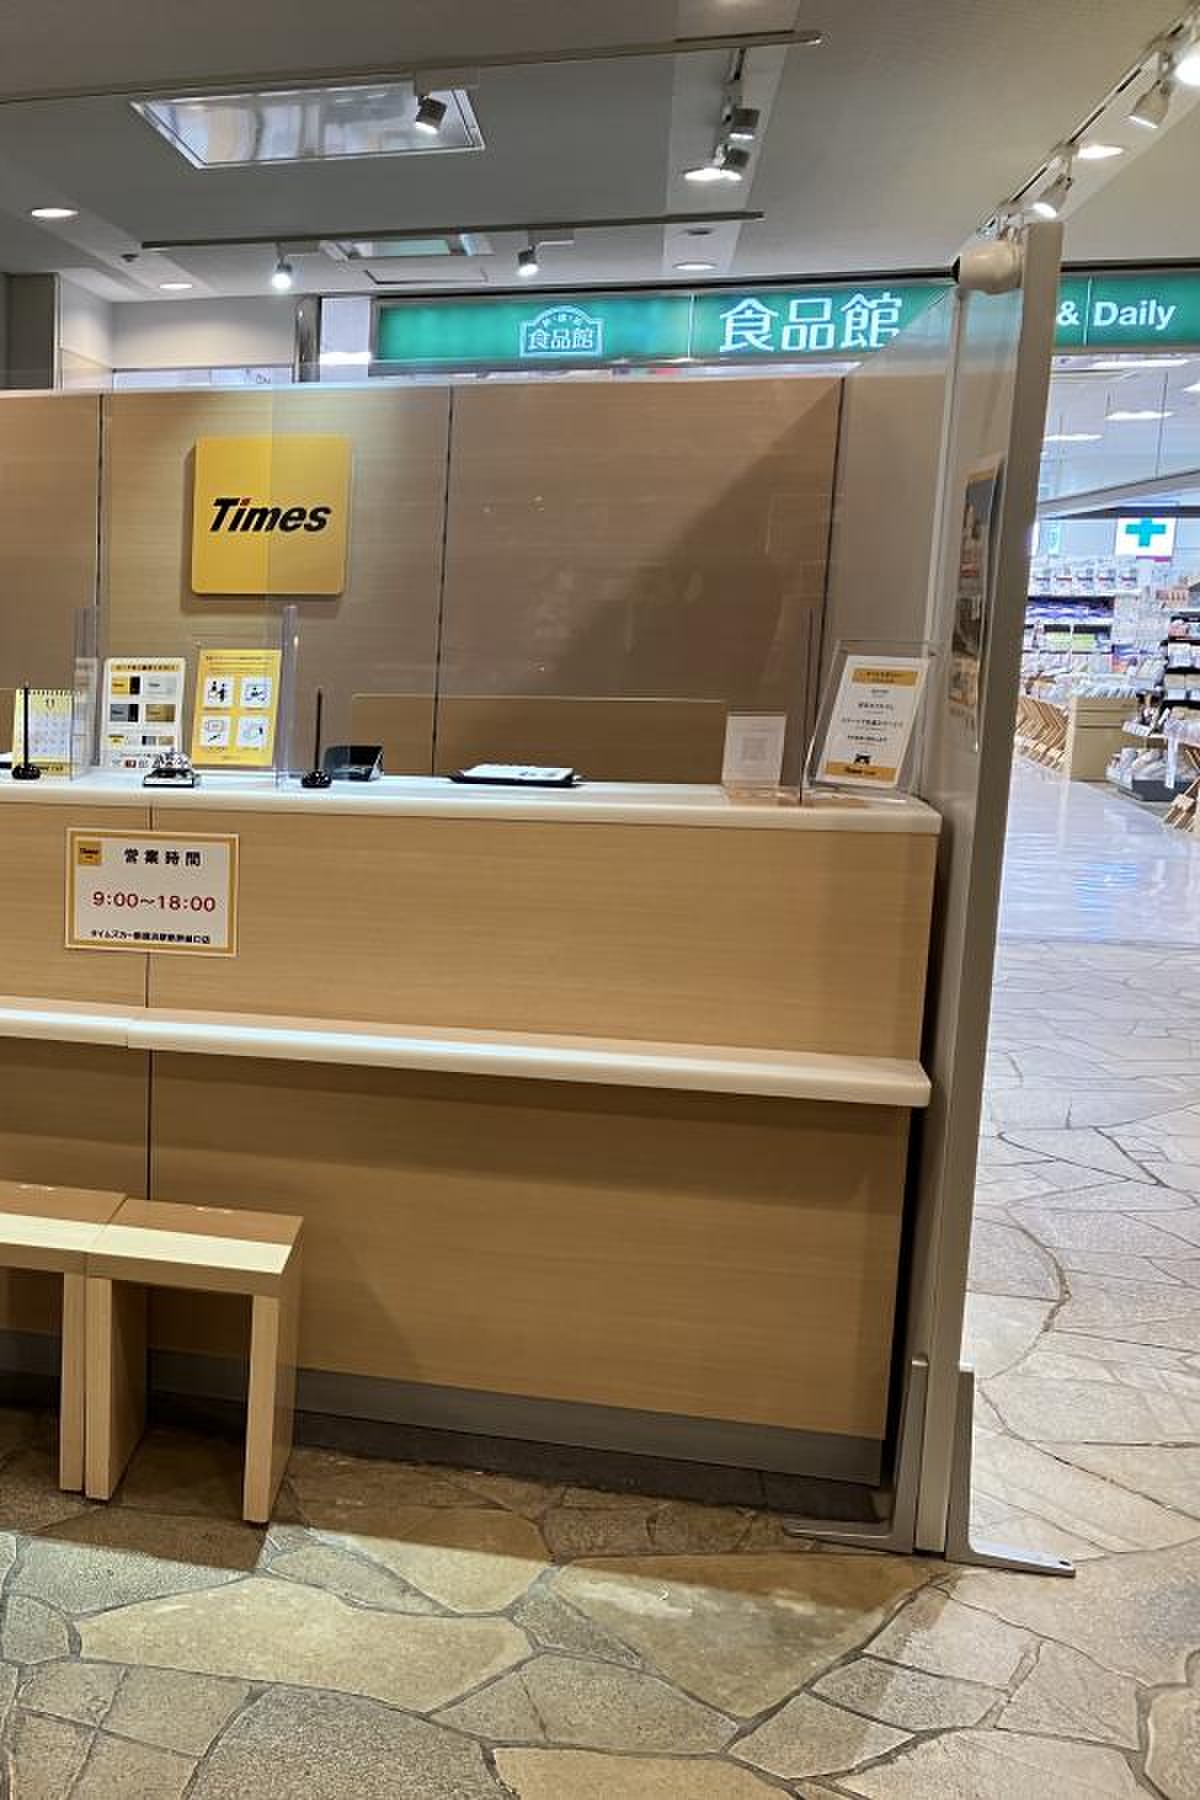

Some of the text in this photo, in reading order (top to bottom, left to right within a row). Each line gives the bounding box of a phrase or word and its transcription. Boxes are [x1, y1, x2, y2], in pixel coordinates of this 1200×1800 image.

[719, 291, 903, 352] 食品館
[1056, 299, 1177, 331] & Daily
[527, 327, 593, 350] 食品館
[209, 497, 332, 532] Times
[123, 848, 201, 867] 営業時間
[92, 890, 216, 912] 9:00～18:00
